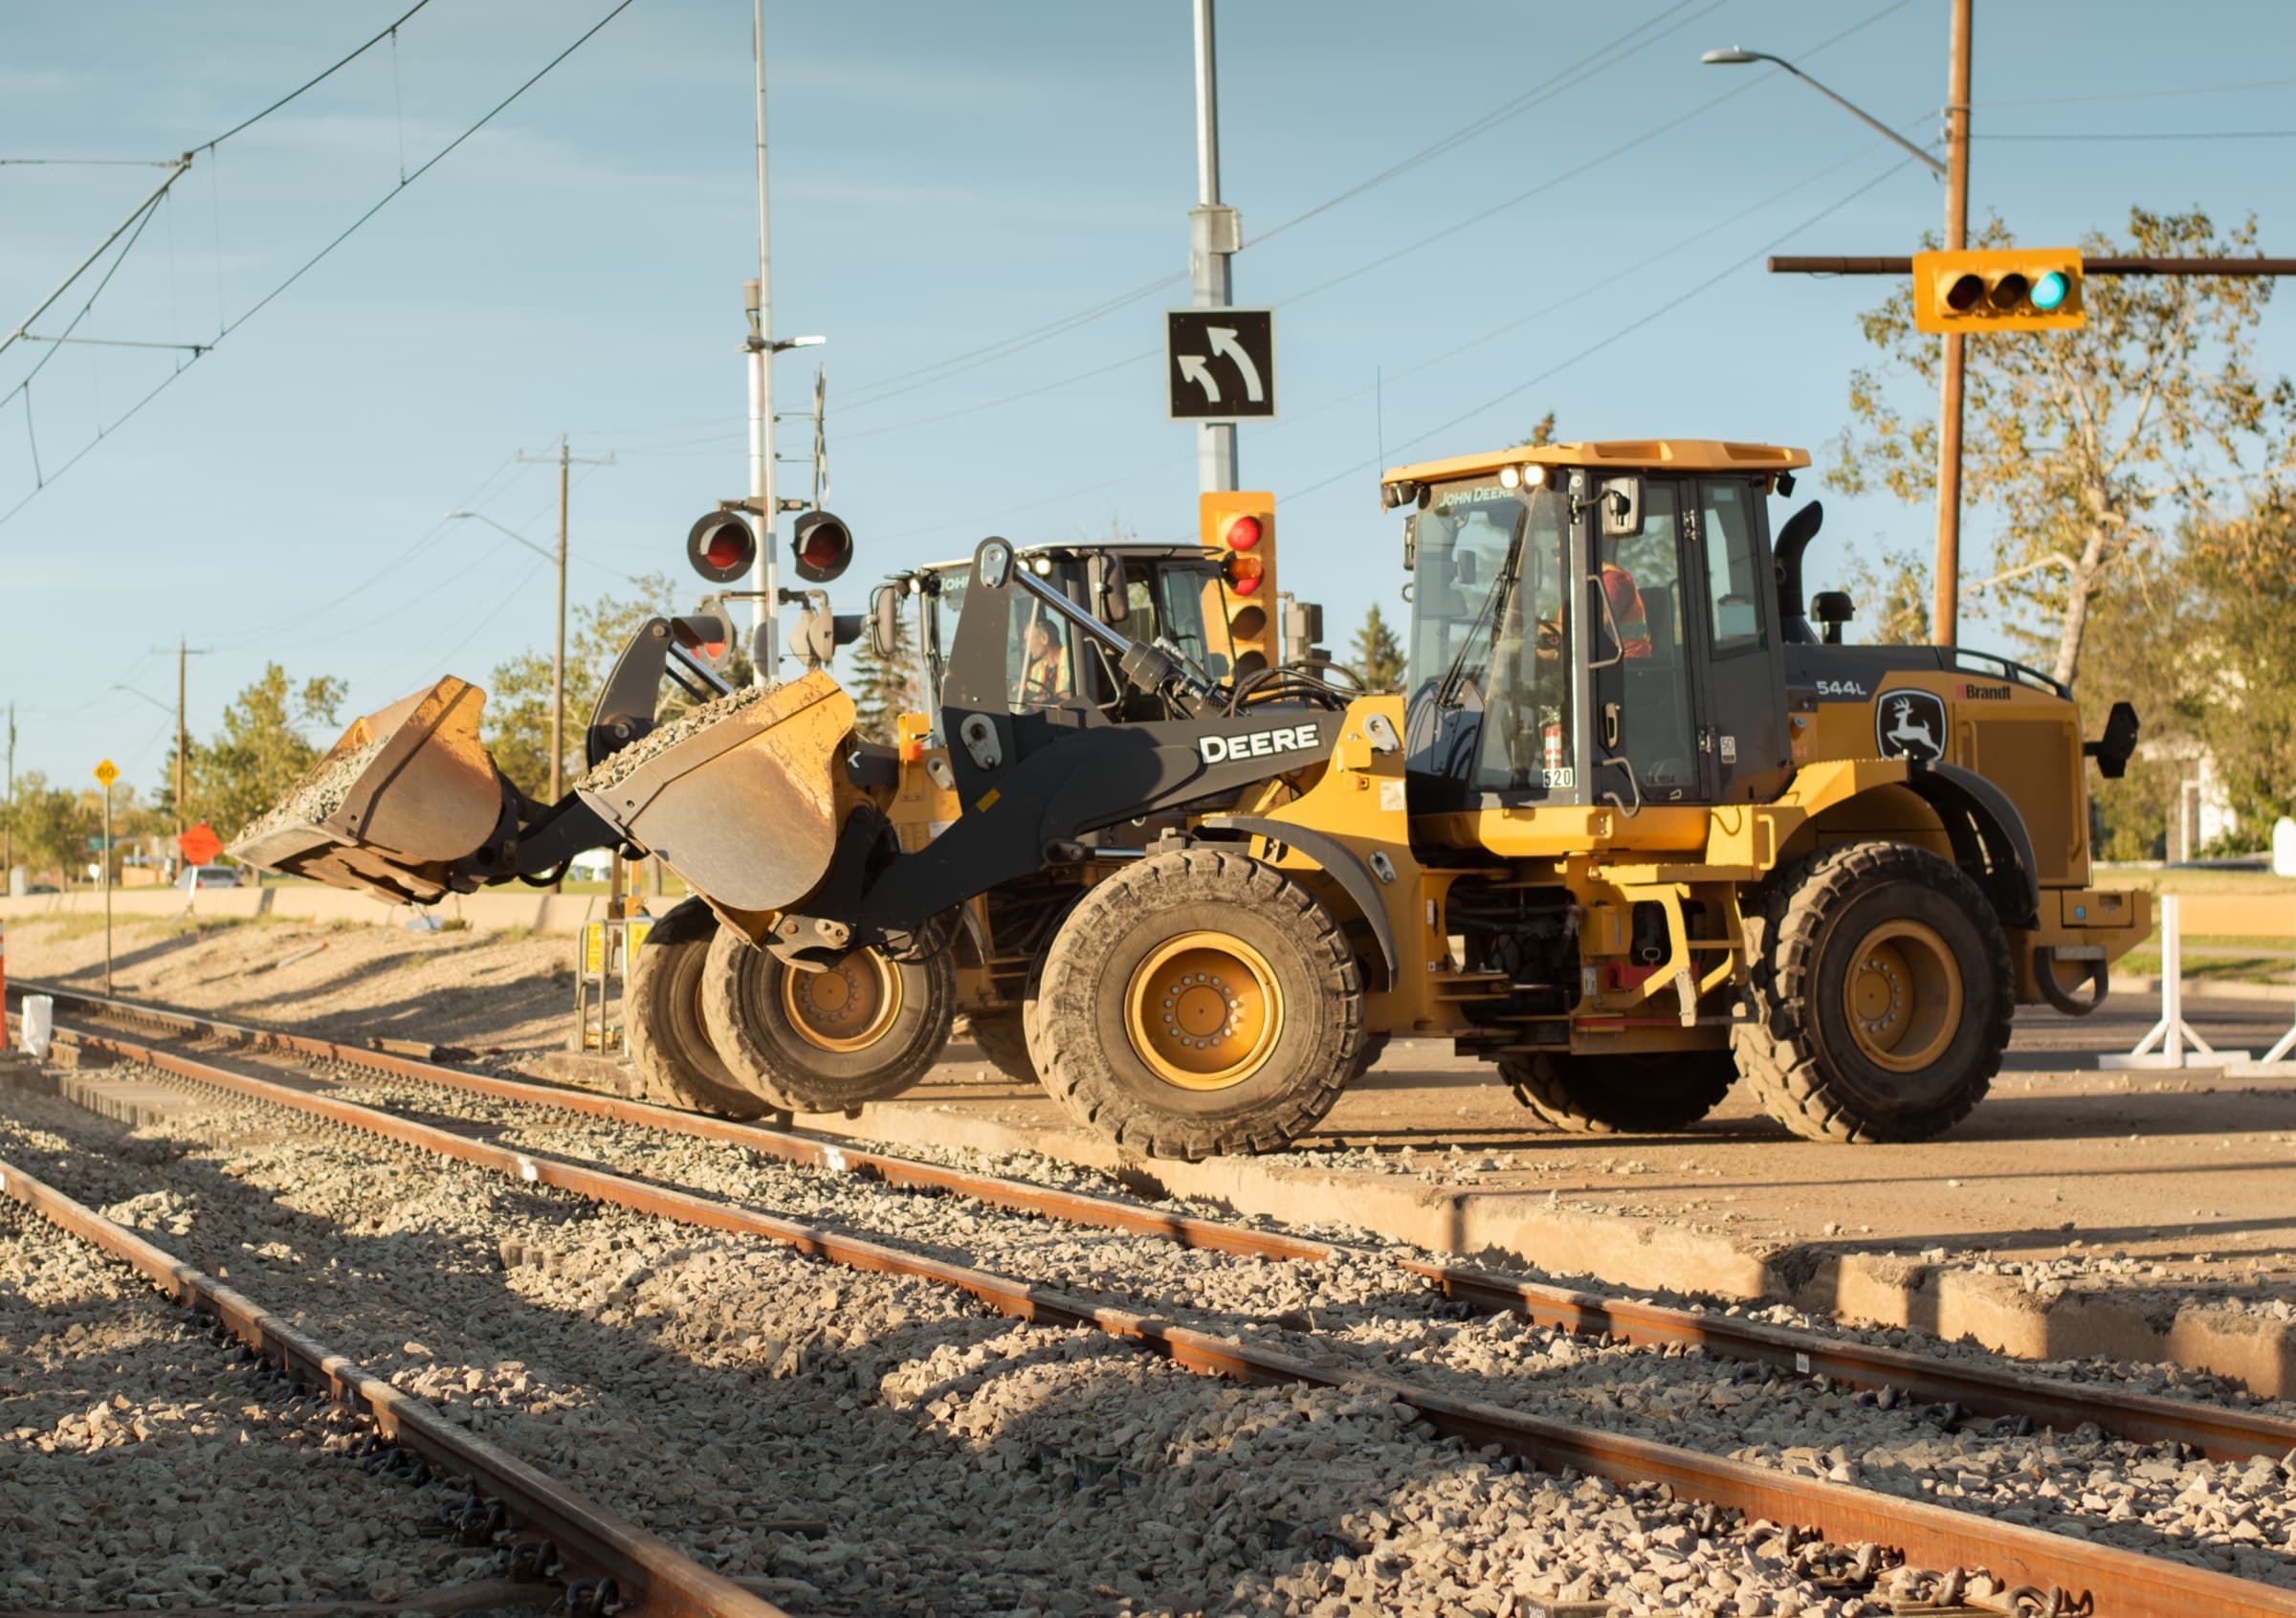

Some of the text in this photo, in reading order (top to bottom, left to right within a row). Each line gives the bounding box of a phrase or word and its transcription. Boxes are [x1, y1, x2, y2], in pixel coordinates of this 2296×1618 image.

[1438, 491, 1472, 507] JOHN
[1816, 680, 1867, 696] 544L
[1966, 683, 2012, 700] Brandt
[1199, 723, 1320, 765] DEERE
[1544, 769, 1572, 787] 520
